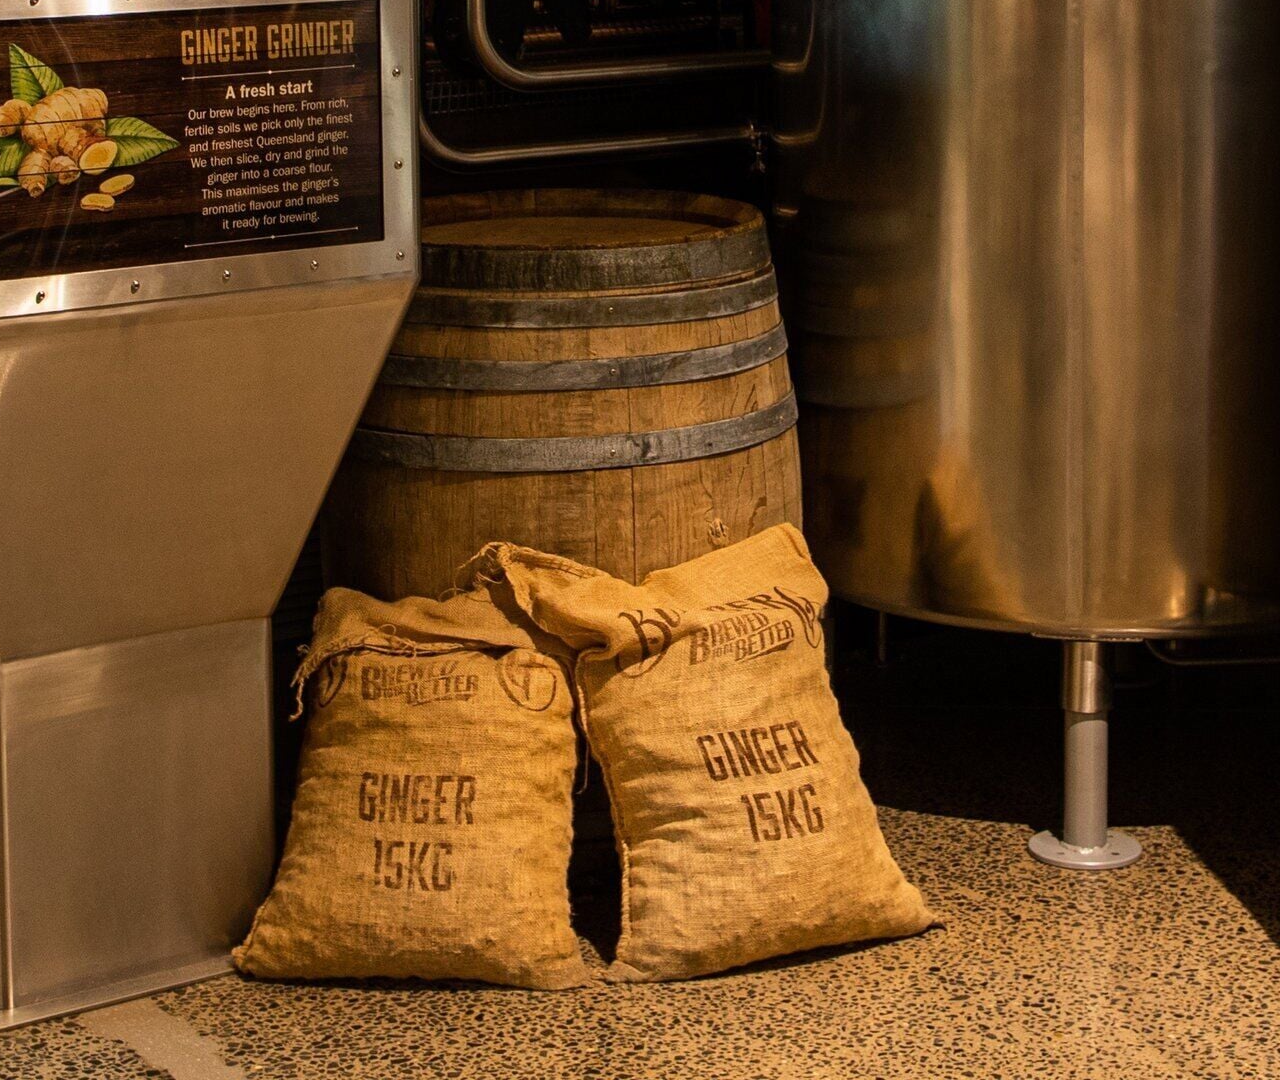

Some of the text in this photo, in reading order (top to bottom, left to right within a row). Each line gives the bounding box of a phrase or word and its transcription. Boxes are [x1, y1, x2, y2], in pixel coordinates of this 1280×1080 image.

[181, 20, 354, 65] GINGER GRINDER
[225, 80, 313, 100] A fresh start
[188, 108, 207, 120] Our
[209, 107, 234, 119] brew
[237, 104, 270, 118] begins
[273, 102, 298, 113] here.
[301, 100, 325, 111] From
[184, 113, 353, 137] fertile soils we pick only the finest
[189, 140, 209, 153] and
[212, 137, 253, 151] freshest
[256, 131, 314, 148] Queensland
[191, 157, 207, 168] We
[210, 155, 233, 167] then
[265, 151, 281, 163] dry
[283, 148, 303, 160] and
[305, 146, 329, 160] grind
[332, 145, 348, 155] the
[207, 171, 238, 186] ginger
[241, 169, 260, 180] into
[263, 169, 270, 177] a
[272, 165, 306, 177] coarse
[201, 188, 223, 200] This
[226, 183, 279, 197] maximises
[282, 180, 299, 191] the
[202, 193, 340, 216] aromatic flavour and makes
[222, 210, 320, 231] it ready for brewing.
[689, 612, 770, 665] BREWED
[735, 619, 794, 662] BETTER
[696, 720, 819, 781] GINGER
[359, 771, 475, 825] GINGER
[740, 783, 824, 842] 15KG
[374, 838, 451, 892] 15KG
